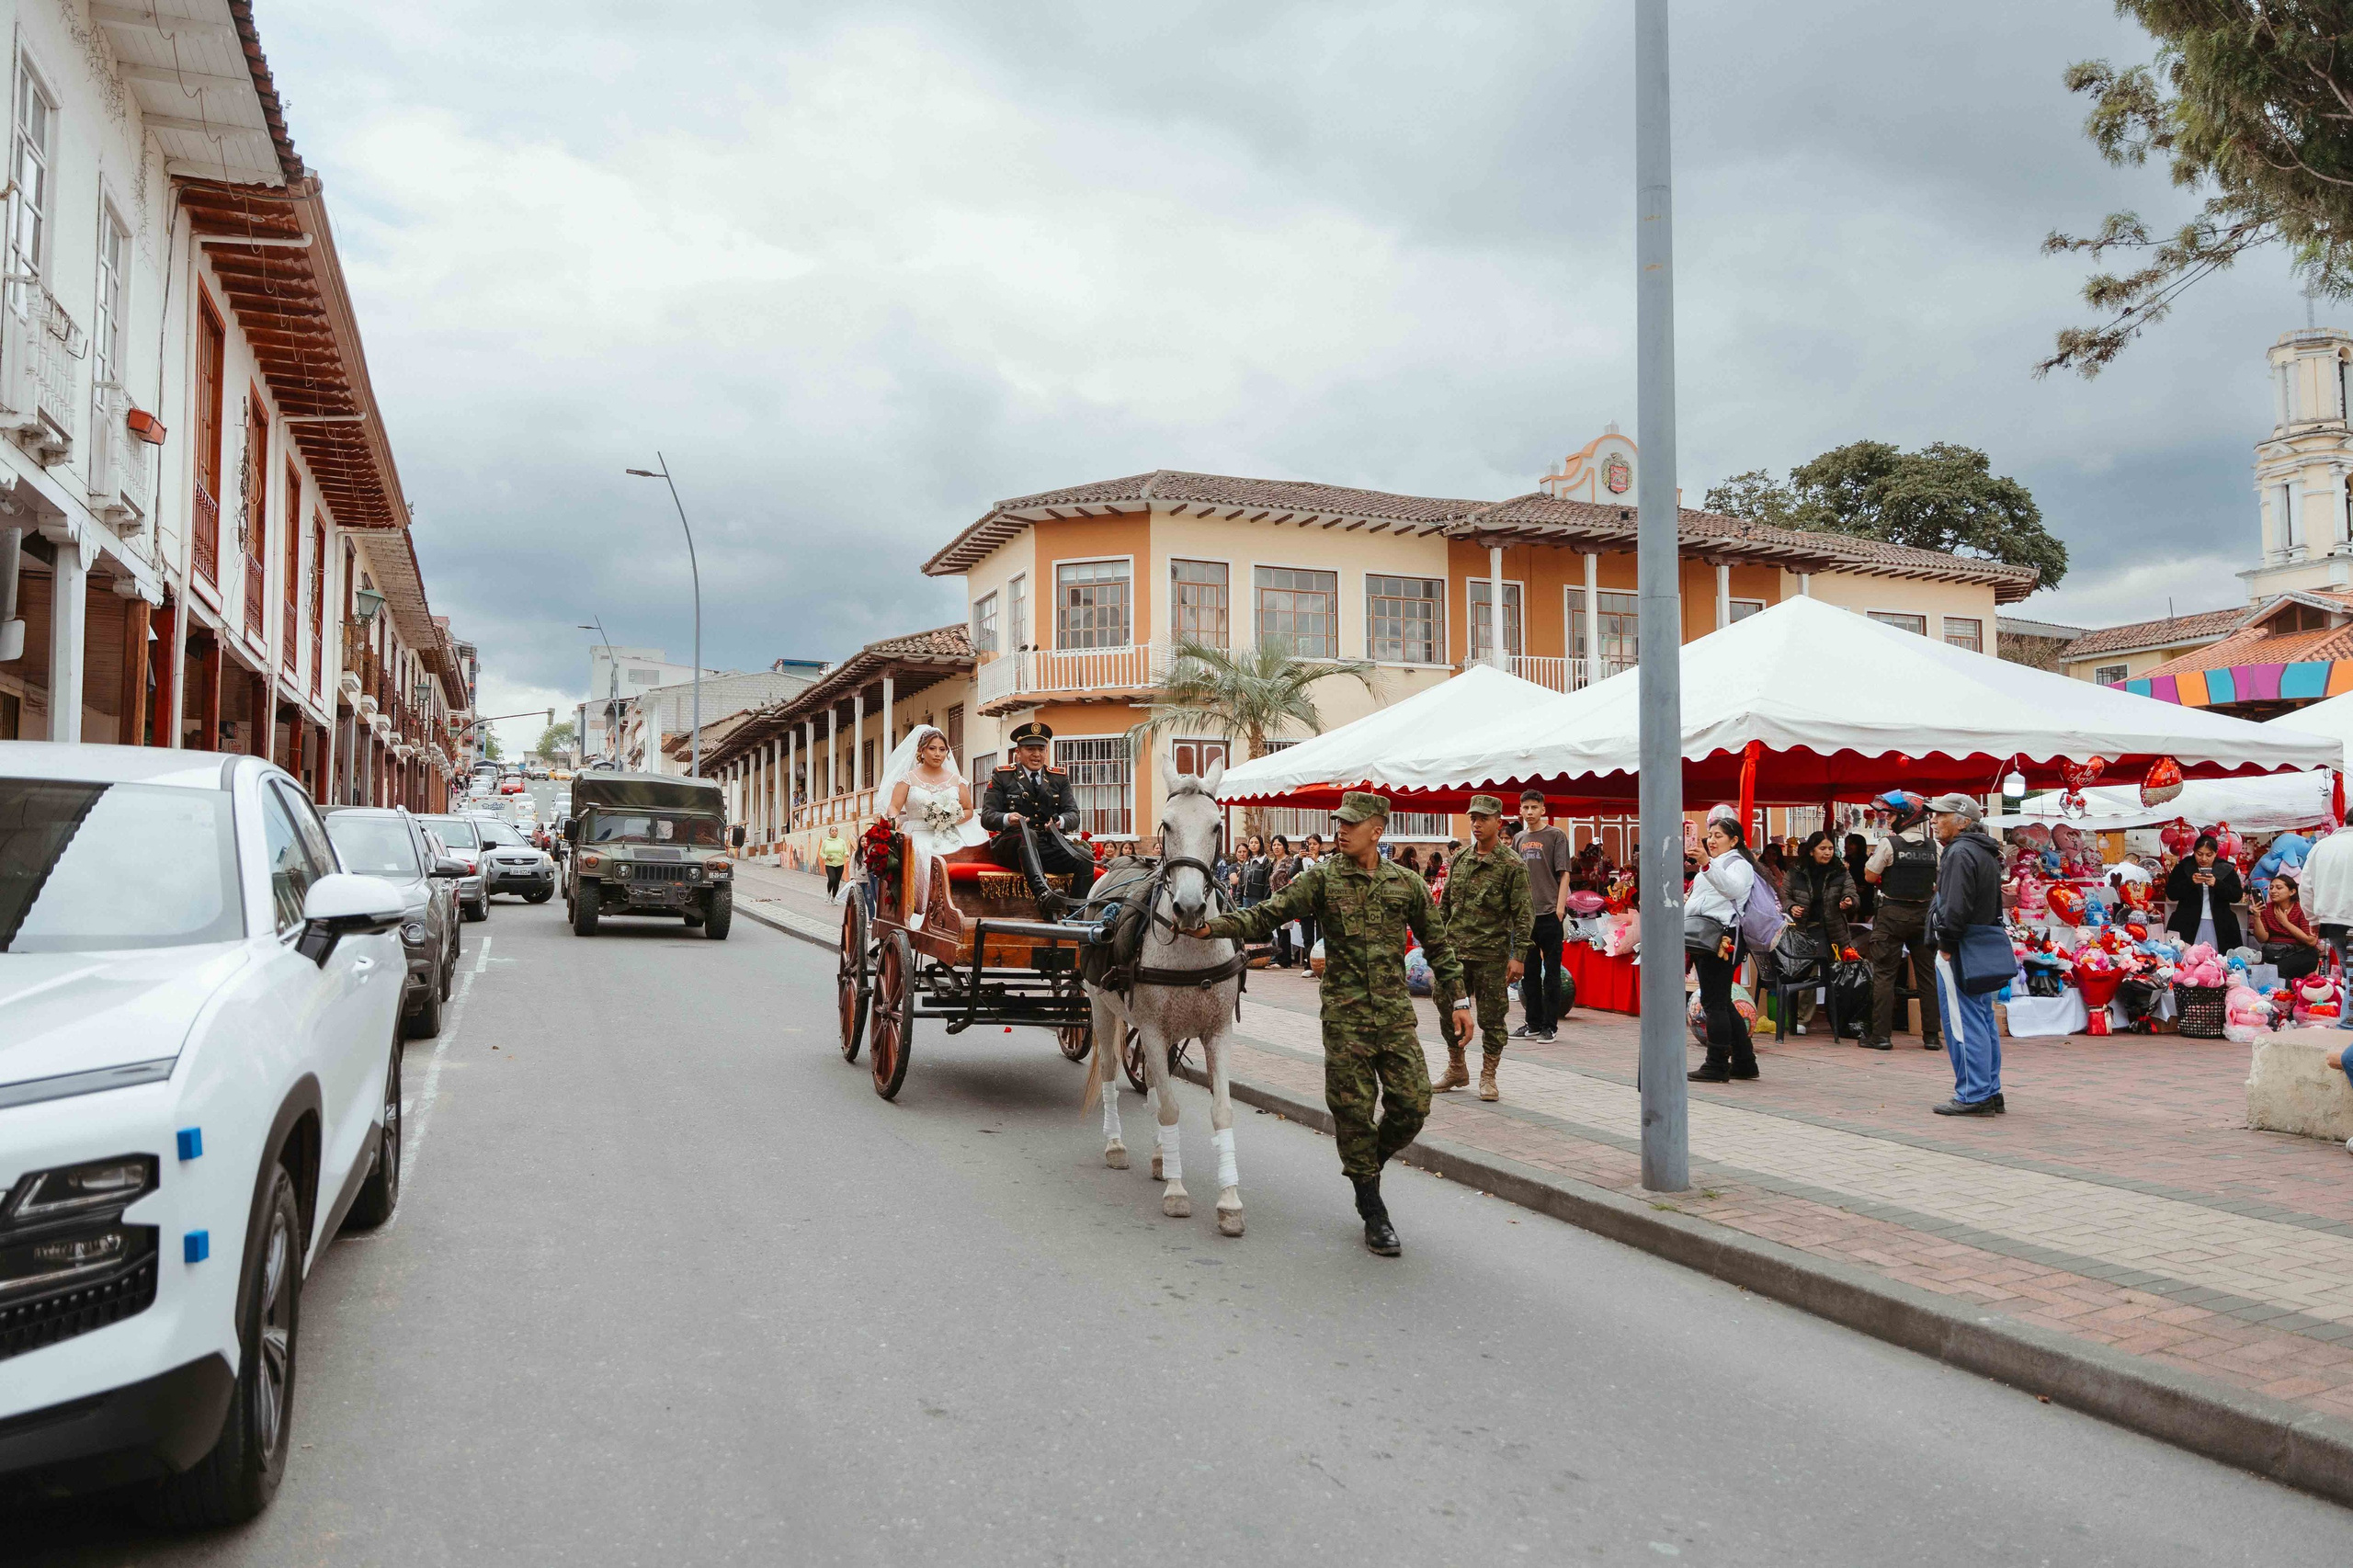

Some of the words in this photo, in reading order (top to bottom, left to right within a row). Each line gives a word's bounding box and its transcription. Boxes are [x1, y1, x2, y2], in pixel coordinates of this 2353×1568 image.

[2083, 762, 2095, 777] Te
[2067, 772, 2095, 785] Amo
[1958, 801, 1967, 812] B
[1898, 851, 1936, 861] POLICIA
[1383, 889, 1414, 897] EJERCITO
